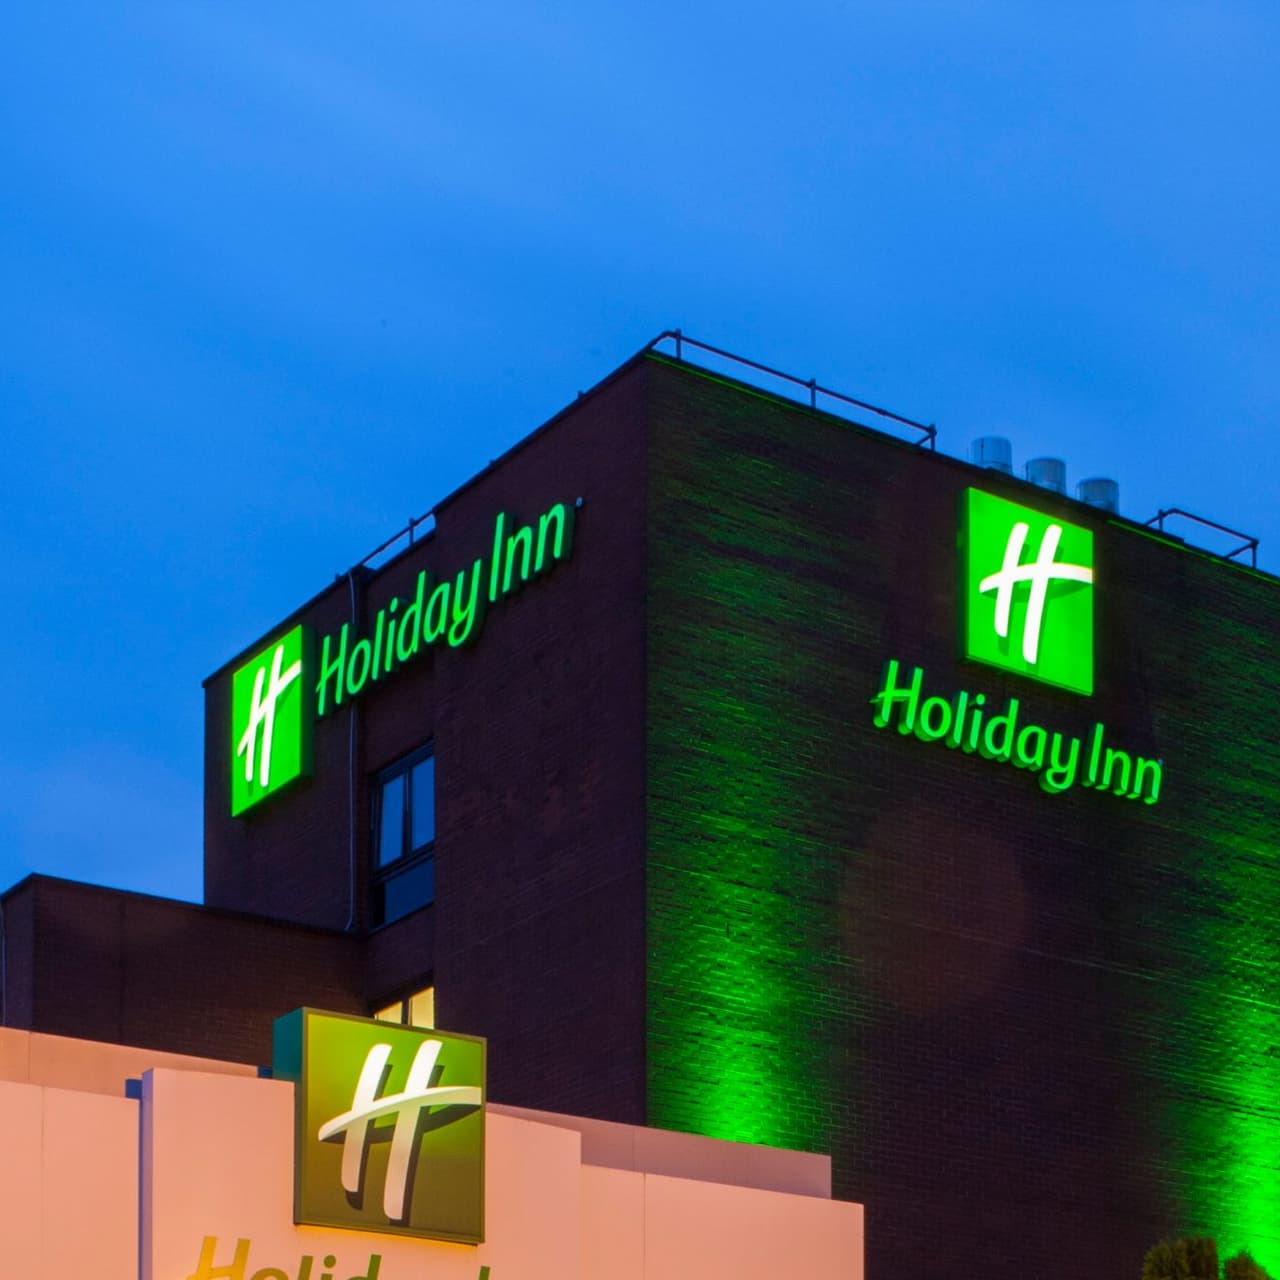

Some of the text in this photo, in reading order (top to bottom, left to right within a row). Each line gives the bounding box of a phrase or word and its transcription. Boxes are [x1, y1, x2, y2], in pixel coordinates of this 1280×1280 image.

[316, 503, 566, 716] Holiday Inn
[979, 521, 1094, 665] H
[236, 643, 302, 787] H
[873, 659, 1162, 804] Holiday Inn
[318, 1038, 483, 1222] H
